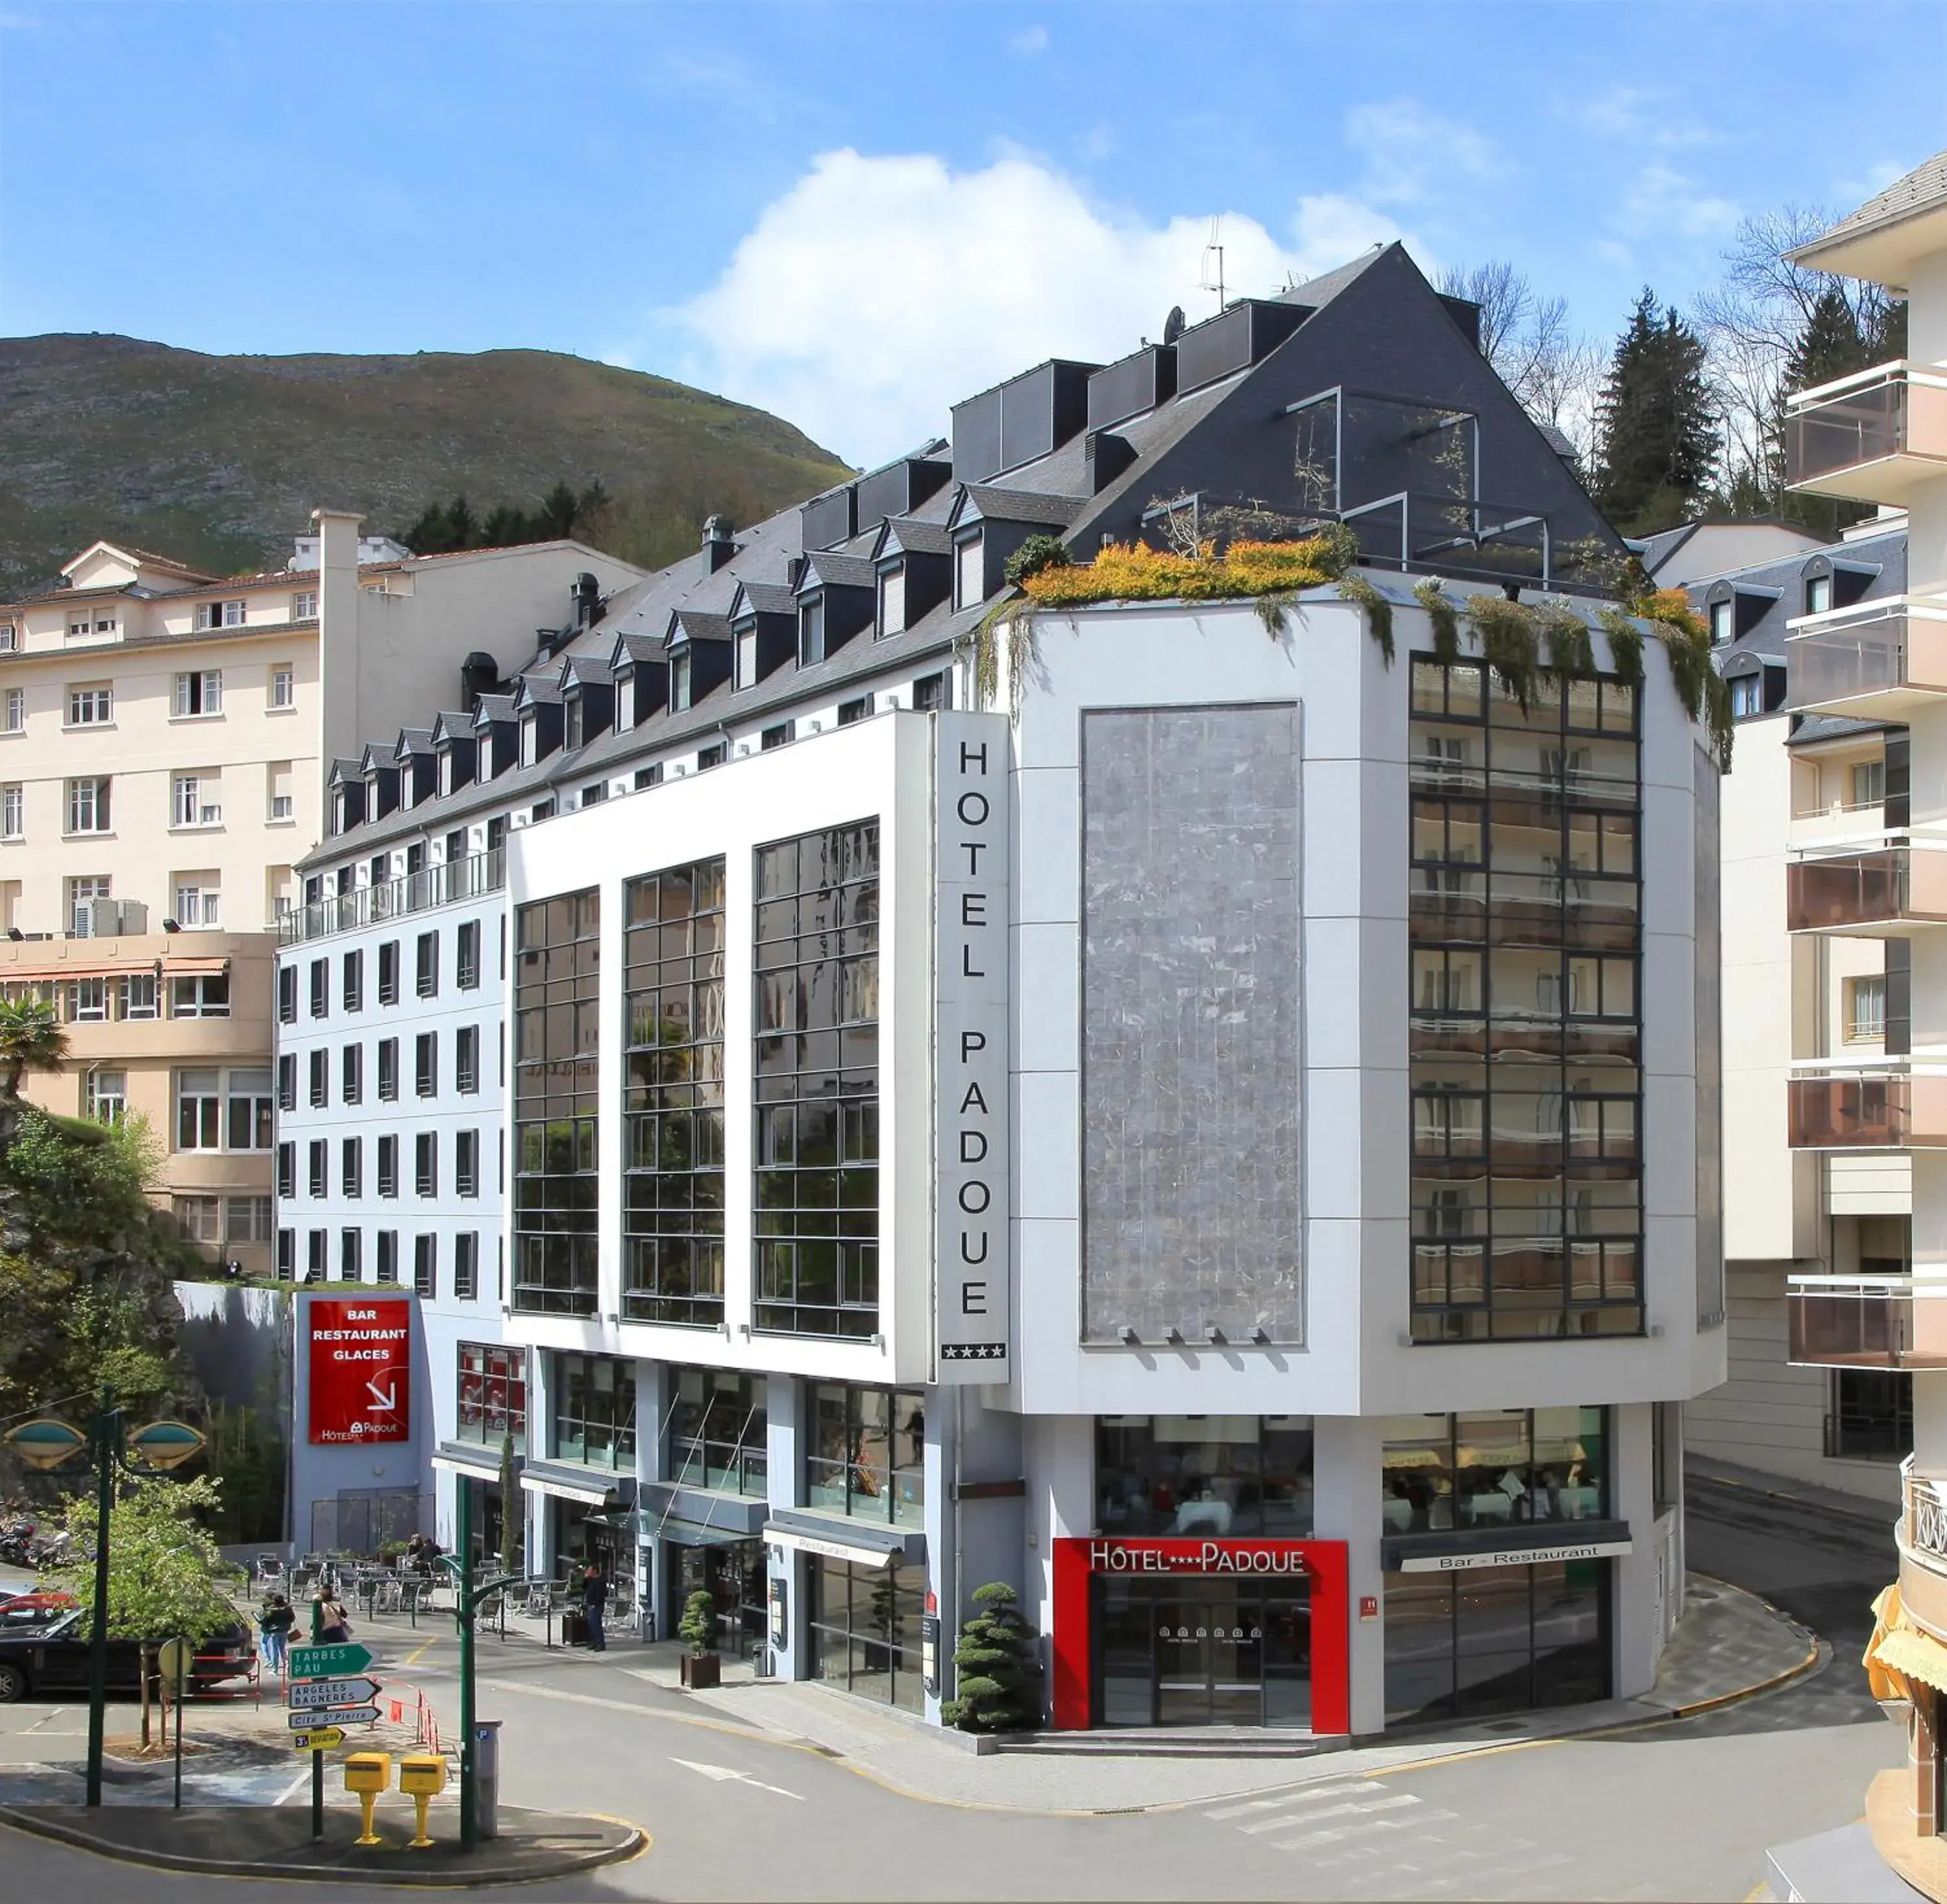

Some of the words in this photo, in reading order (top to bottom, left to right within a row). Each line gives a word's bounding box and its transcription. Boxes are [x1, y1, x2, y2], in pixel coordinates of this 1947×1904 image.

[957, 741, 990, 977] HOTEL
[958, 1031, 991, 1314] PADOUE
[347, 1310, 377, 1320] BAR
[313, 1328, 407, 1340] RESTAURANT
[333, 1349, 390, 1360] GLACES
[363, 1422, 398, 1434] PADOUE
[1090, 1541, 1171, 1571] HÔTEL
[1201, 1542, 1304, 1572] PADOUE
[1439, 1558, 1475, 1568] Bar
[1494, 1546, 1598, 1564] Restaurant
[294, 1649, 346, 1662] TARBES
[294, 1663, 321, 1674] PAU
[480, 1729, 487, 1739] P
